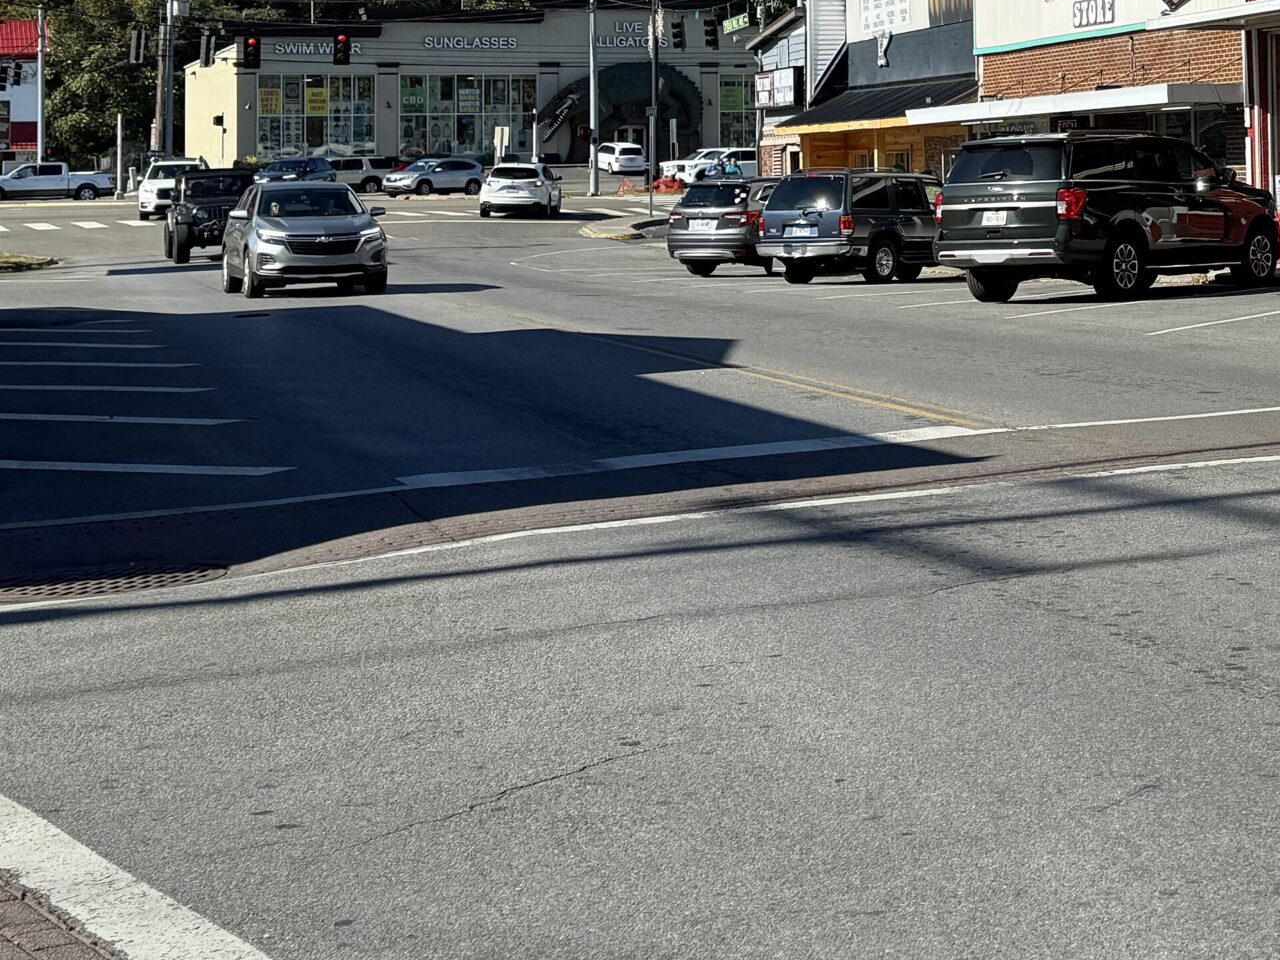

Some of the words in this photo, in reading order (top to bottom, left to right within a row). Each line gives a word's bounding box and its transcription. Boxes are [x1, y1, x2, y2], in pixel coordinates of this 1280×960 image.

[615, 21, 643, 33] LIVE
[424, 37, 517, 49] SUNGLASSES
[596, 36, 669, 48] LLIGATOS
[275, 43, 314, 54] SWIM
[402, 96, 424, 104] CBD
